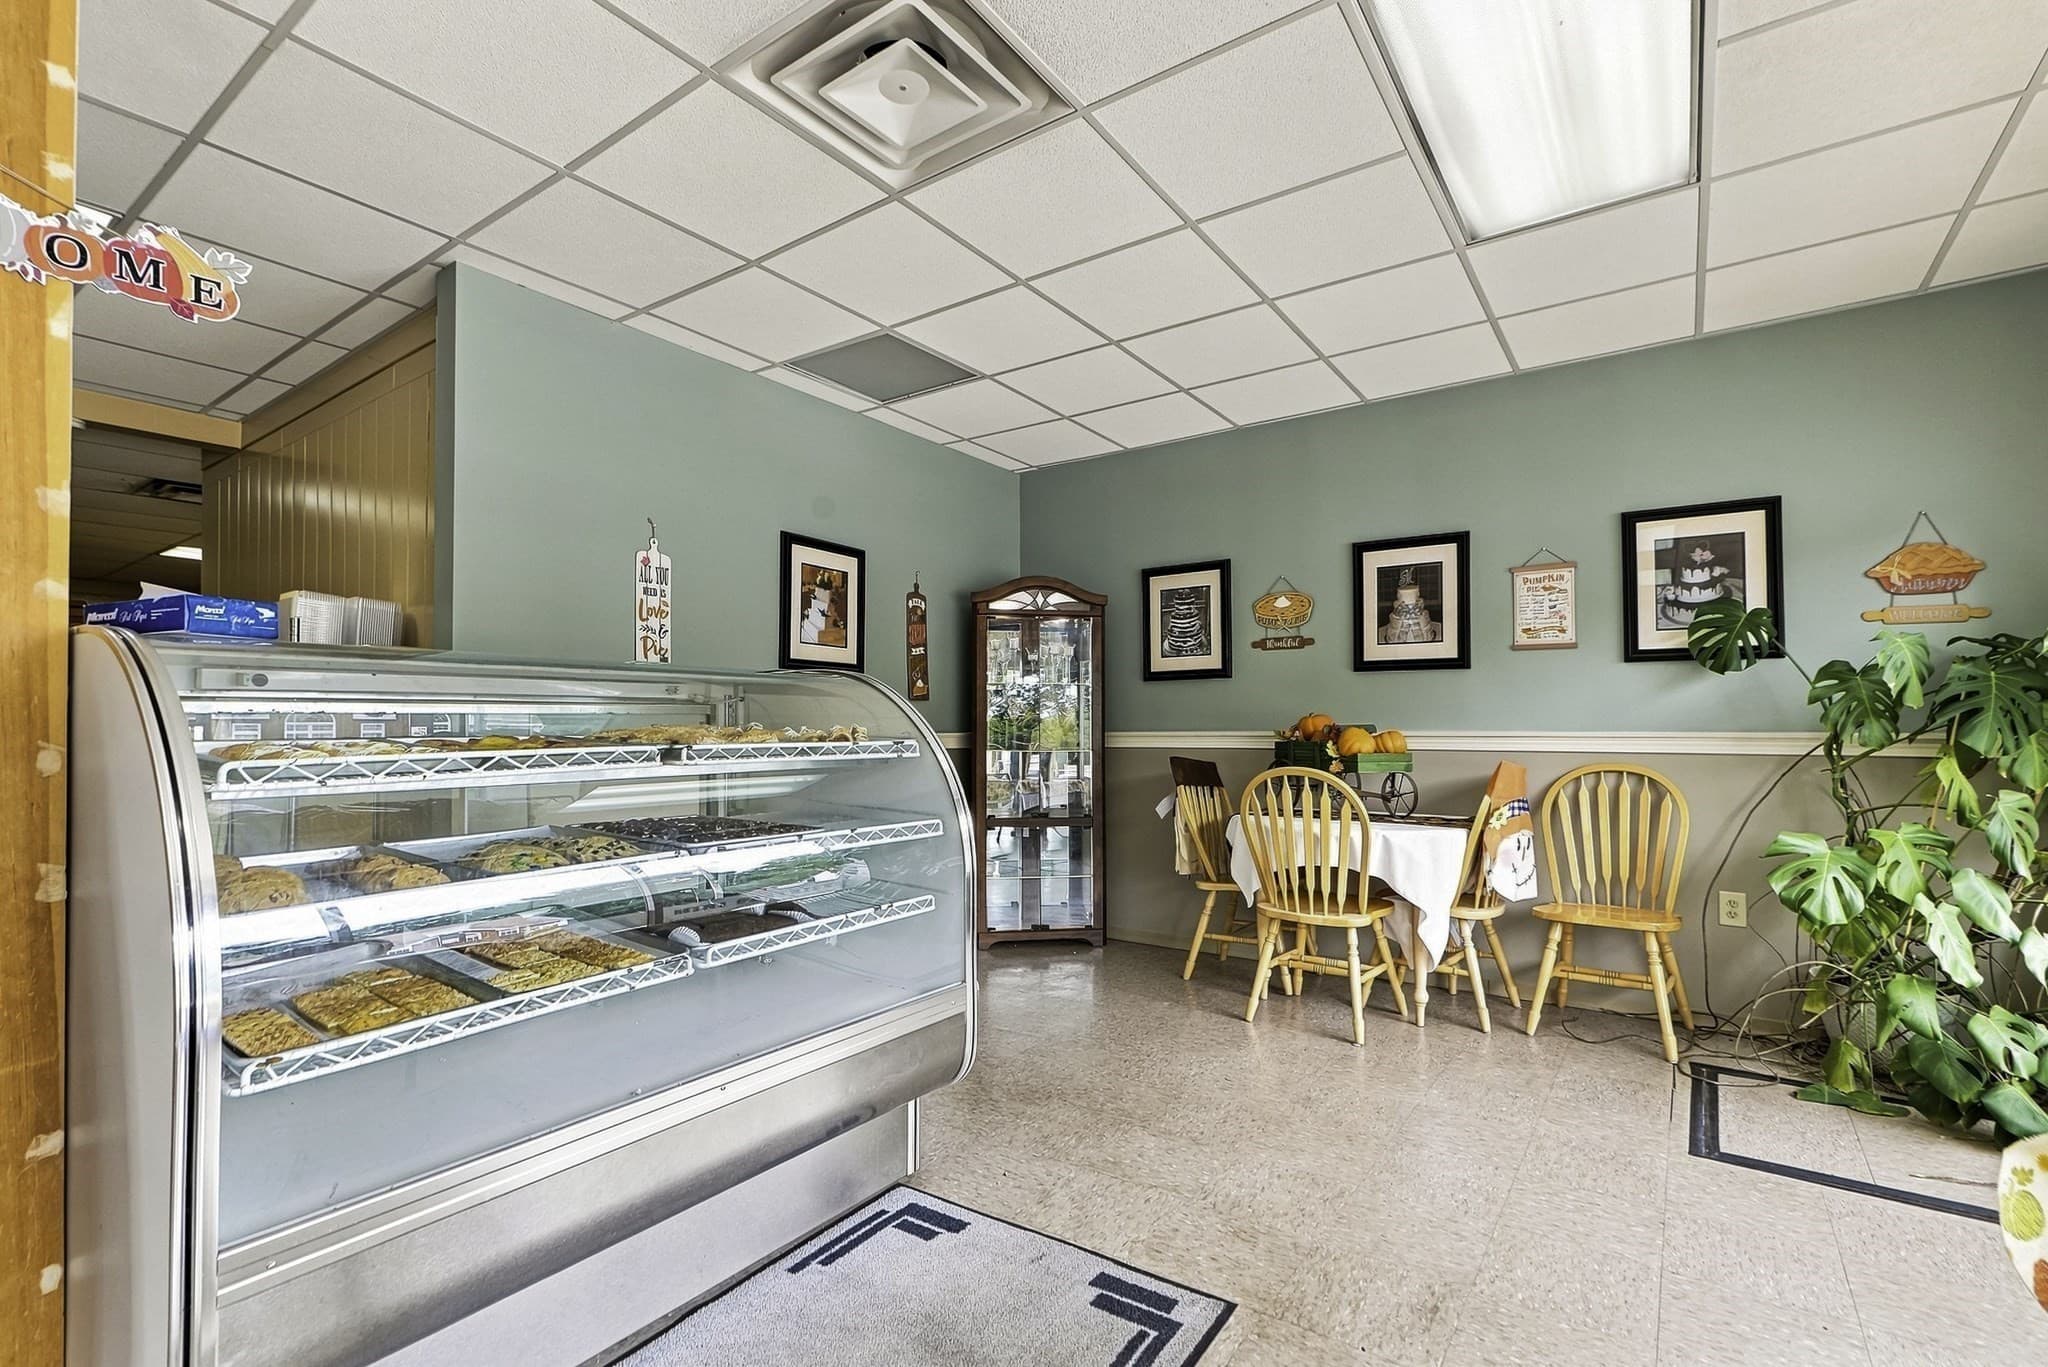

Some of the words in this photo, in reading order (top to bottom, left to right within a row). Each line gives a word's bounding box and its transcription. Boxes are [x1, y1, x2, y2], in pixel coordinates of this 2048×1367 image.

[639, 565, 653, 584] ALL
[655, 567, 669, 586] YOU
[1522, 573, 1566, 586] PUMPKIN
[643, 586, 658, 597] NEED
[638, 598, 669, 622] Love
[640, 635, 668, 660] Pie
